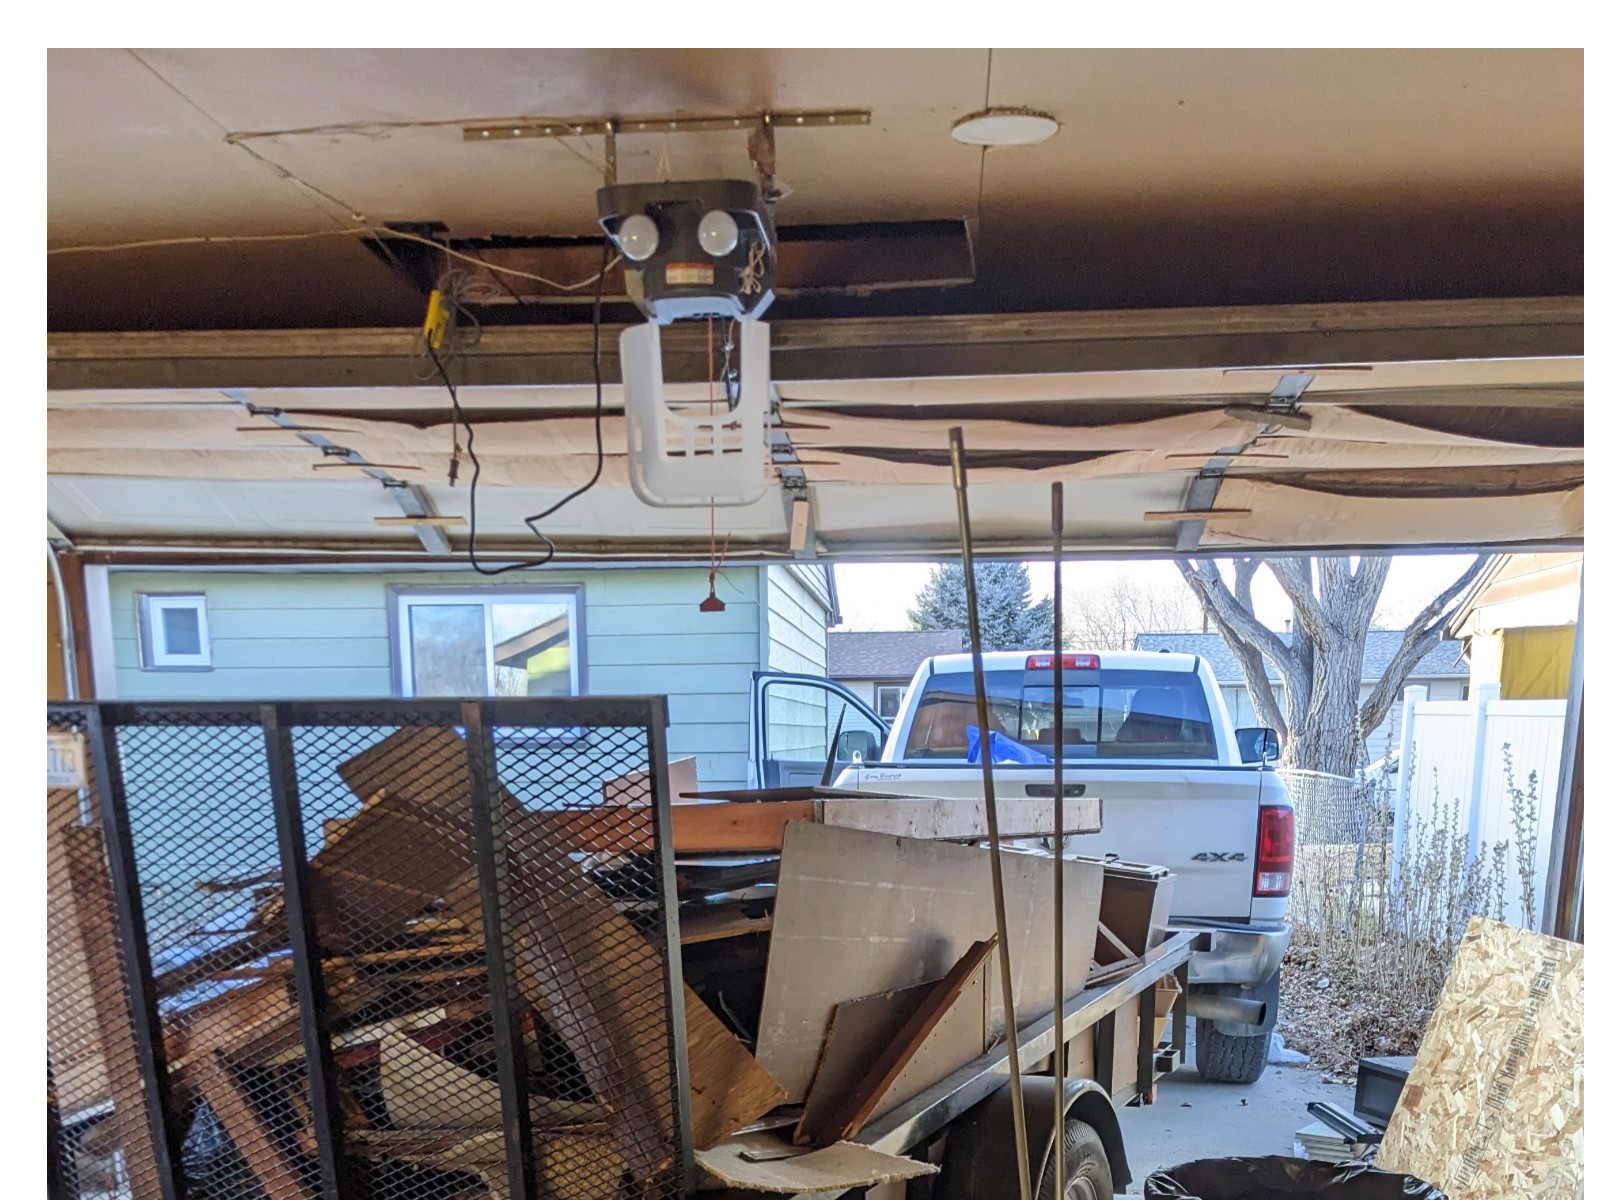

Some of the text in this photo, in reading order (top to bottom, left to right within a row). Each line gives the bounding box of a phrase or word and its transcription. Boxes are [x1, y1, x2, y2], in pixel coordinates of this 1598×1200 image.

[47, 748, 76, 773] 773
[1191, 852, 1248, 862] 4X4
[1534, 979, 1550, 990] APA
